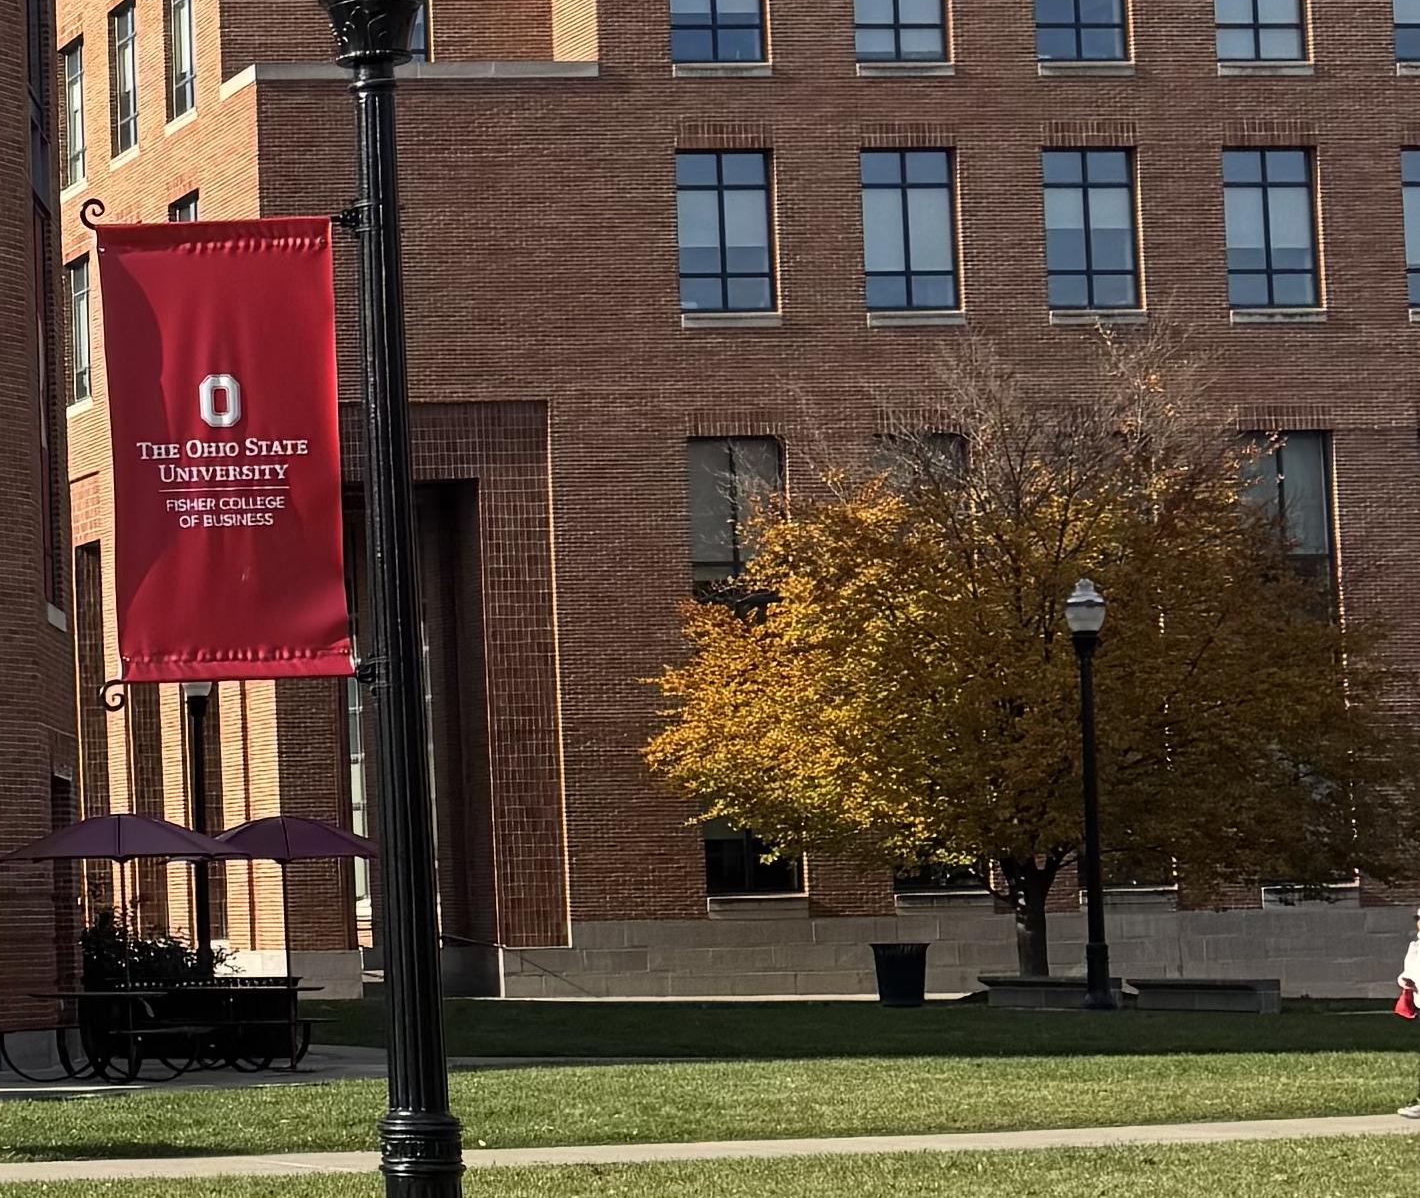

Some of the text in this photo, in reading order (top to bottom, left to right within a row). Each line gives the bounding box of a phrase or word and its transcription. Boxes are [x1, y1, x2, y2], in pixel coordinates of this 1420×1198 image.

[198, 373, 242, 428] O
[136, 437, 308, 460] THE OHIO STATE
[158, 464, 290, 483] UNIVERSITY
[166, 496, 285, 512] FISHER COLLEGE
[179, 513, 274, 529] OF BUSINESS
